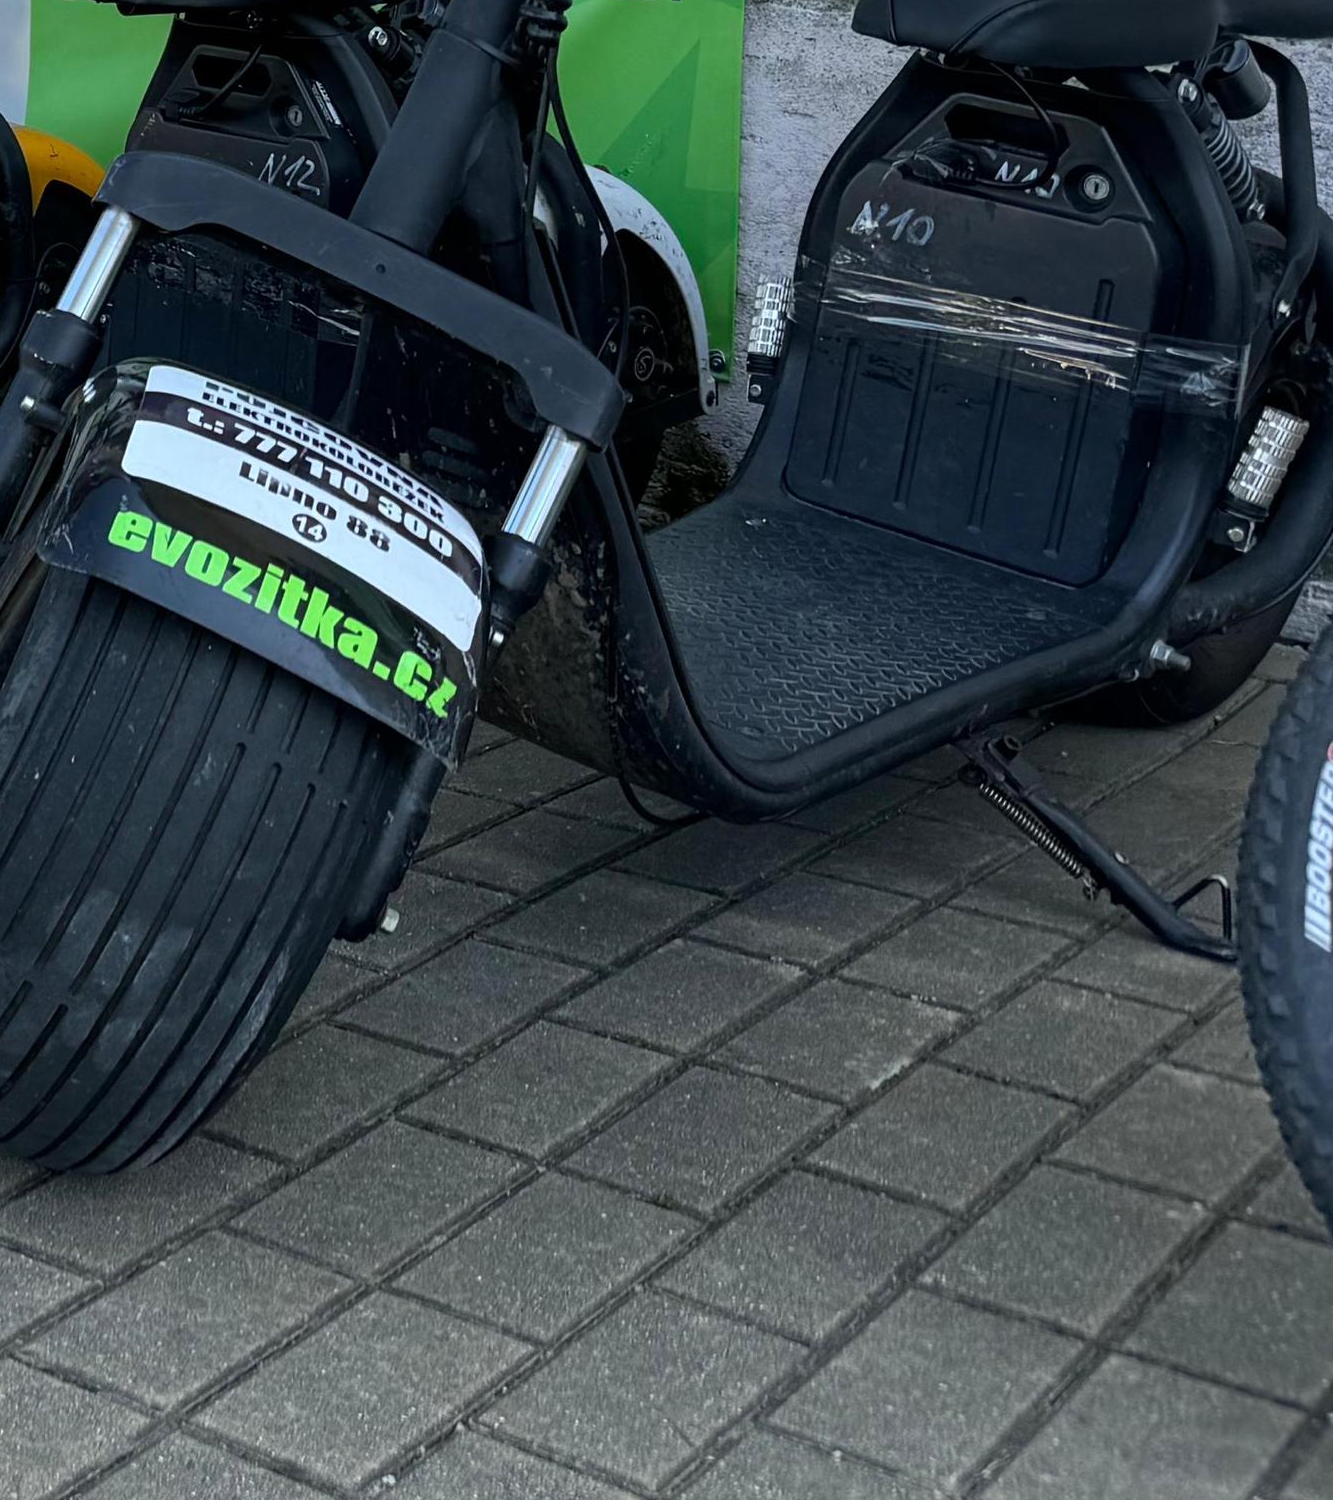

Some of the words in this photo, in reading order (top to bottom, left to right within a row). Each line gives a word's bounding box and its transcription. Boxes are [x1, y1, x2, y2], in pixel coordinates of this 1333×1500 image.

[258, 153, 321, 196] N12
[234, 422, 298, 463] 777
[304, 455, 370, 503] 110
[377, 495, 453, 558] 300
[238, 461, 337, 521] Lipno
[346, 515, 390, 554] 88
[108, 510, 458, 719] evozitka.cz
